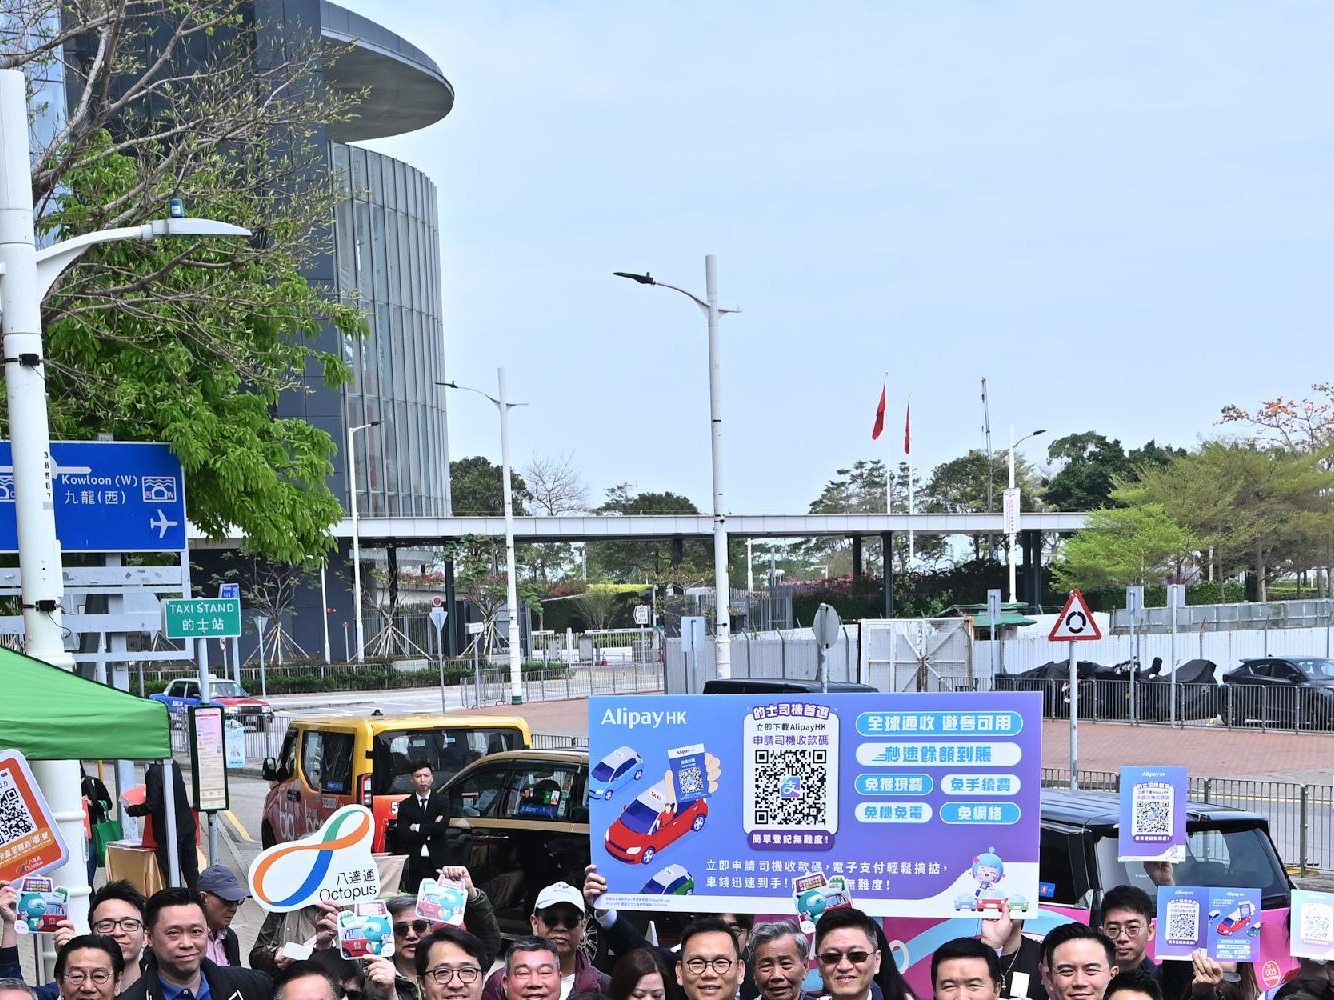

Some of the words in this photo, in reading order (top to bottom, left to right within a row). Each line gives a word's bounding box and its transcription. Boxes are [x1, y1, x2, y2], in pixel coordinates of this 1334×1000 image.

[61, 474, 112, 486] Kowloon
[115, 474, 138, 487] (W)
[64, 490, 126, 505] 九龍(西)
[170, 604, 194, 614] TAXI
[196, 603, 235, 613] STAND
[182, 618, 224, 631] 的士站
[867, 715, 935, 732] 全球通收
[942, 715, 1012, 731] 遊客可用
[753, 735, 830, 746] 申請司機收款碼
[951, 777, 1011, 792] 免手續費
[335, 868, 375, 884] 八達通
[319, 884, 378, 902] Octopus
